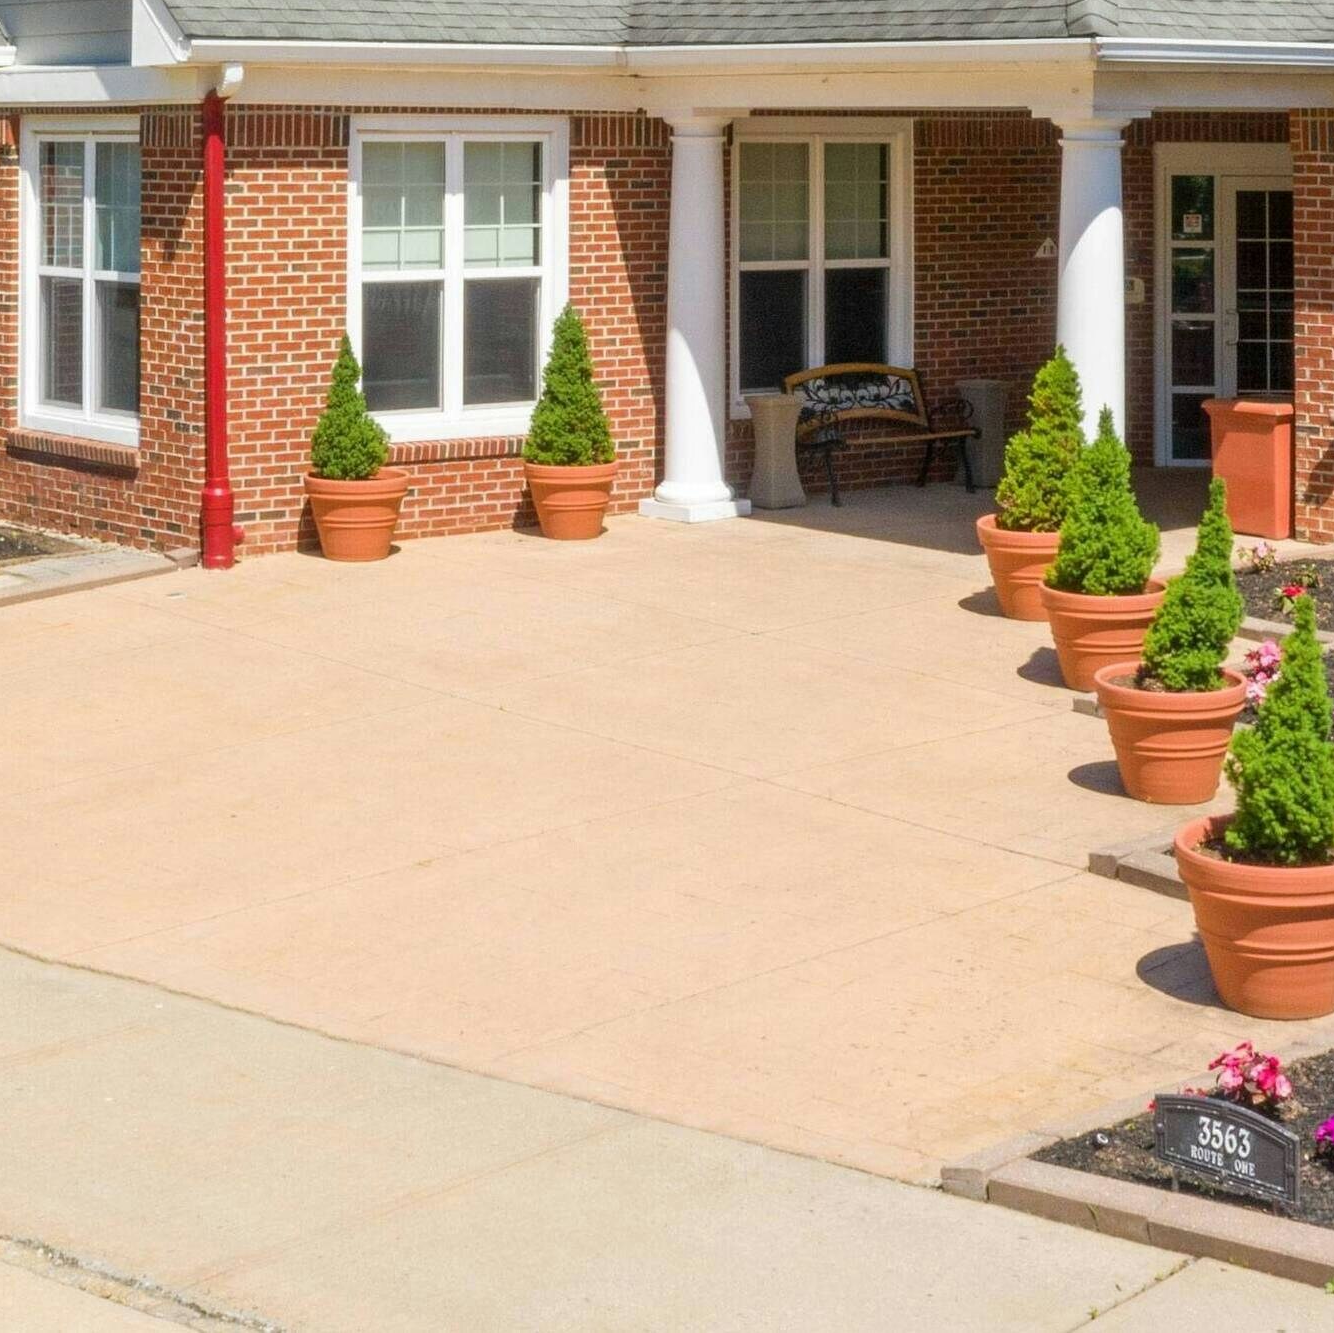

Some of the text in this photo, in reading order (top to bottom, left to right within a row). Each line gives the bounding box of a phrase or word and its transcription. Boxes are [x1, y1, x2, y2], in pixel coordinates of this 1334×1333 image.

[1197, 1116, 1251, 1158] 3563
[1190, 1145, 1256, 1176] ROUTE ONE
